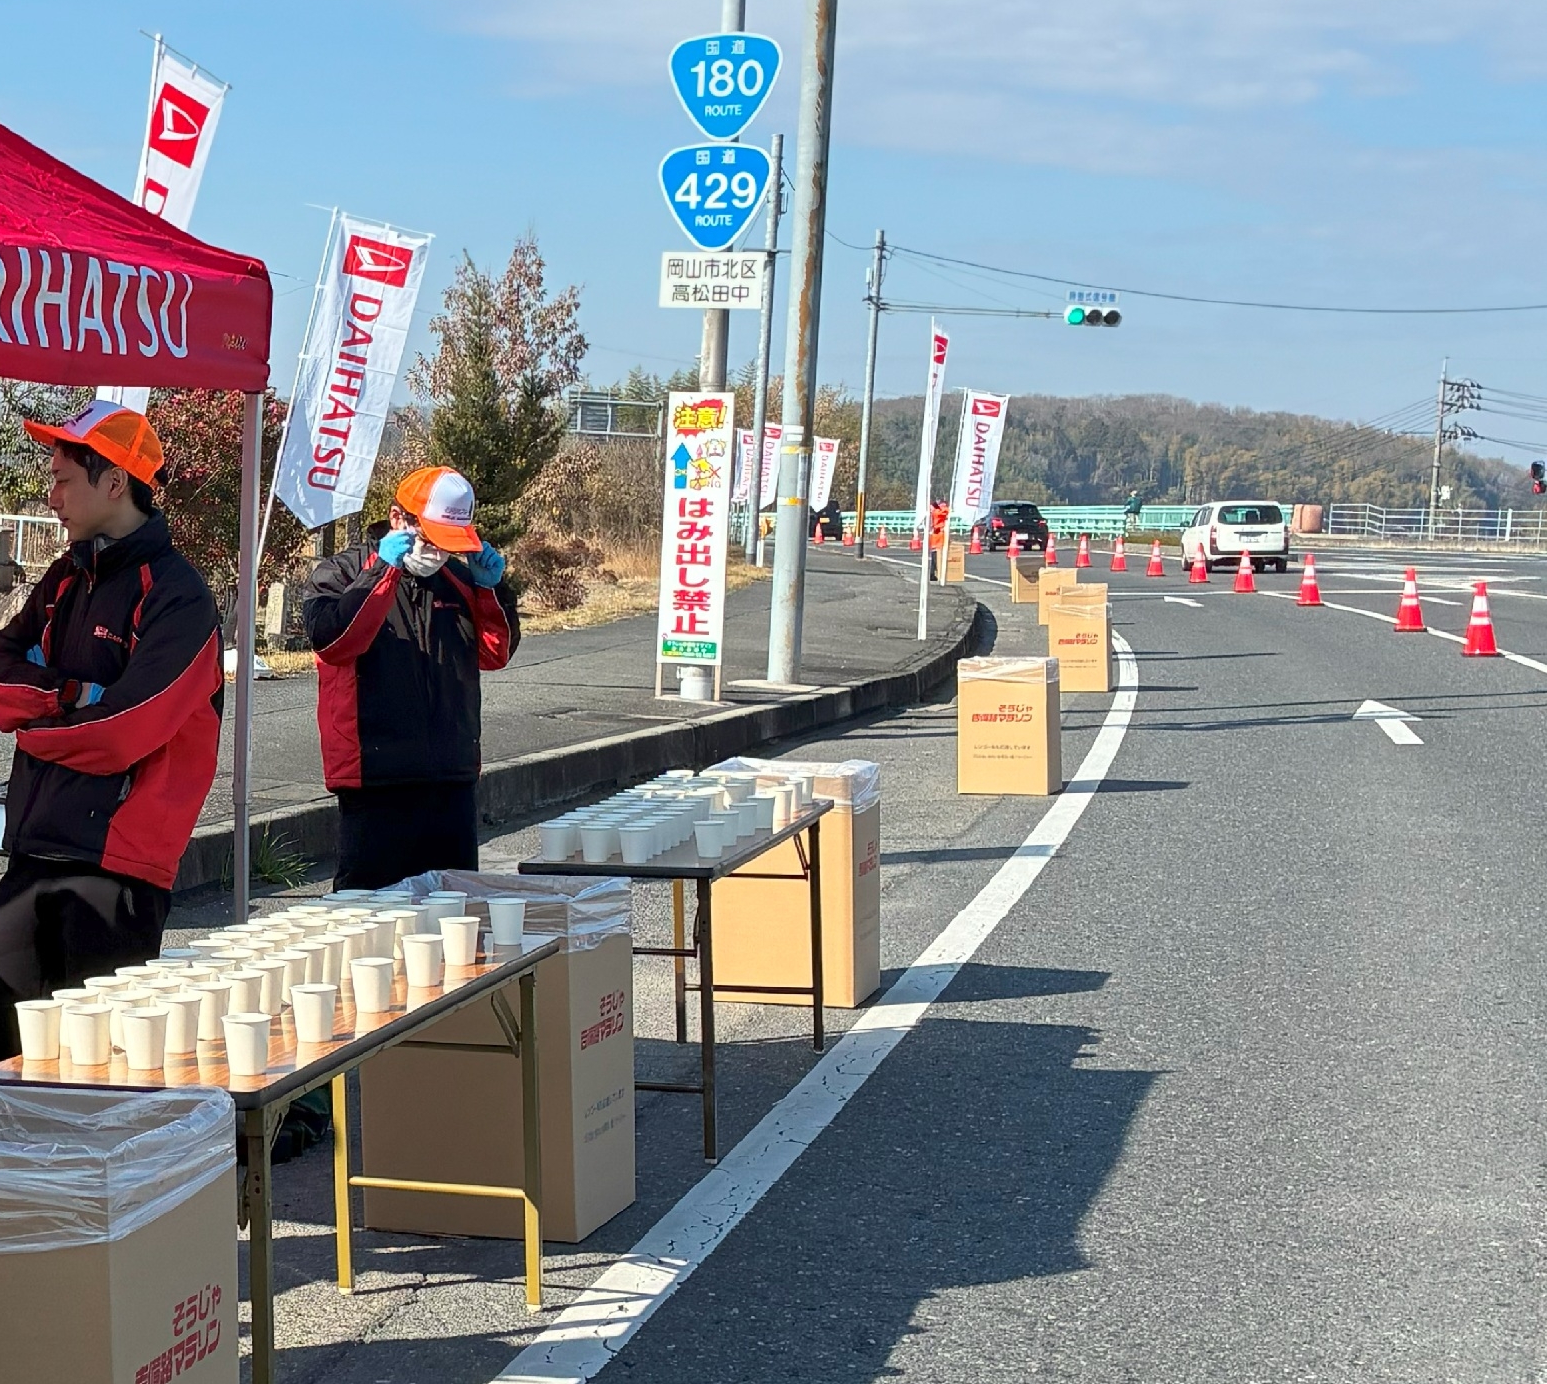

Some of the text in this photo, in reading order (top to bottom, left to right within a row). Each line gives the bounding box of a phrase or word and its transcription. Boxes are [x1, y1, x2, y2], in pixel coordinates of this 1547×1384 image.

[690, 59, 765, 98] 180
[704, 104, 742, 116] ROUTE
[674, 171, 758, 209] 429
[694, 215, 733, 227] ROUTE
[667, 258, 758, 280] 岡山市北区
[671, 284, 751, 303] 高松田中
[307, 292, 383, 491] DAIHATSU
[966, 421, 991, 508] DAIHATSU
[670, 496, 714, 636] はみ出し禁止
[172, 1284, 221, 1337] そうじゃ
